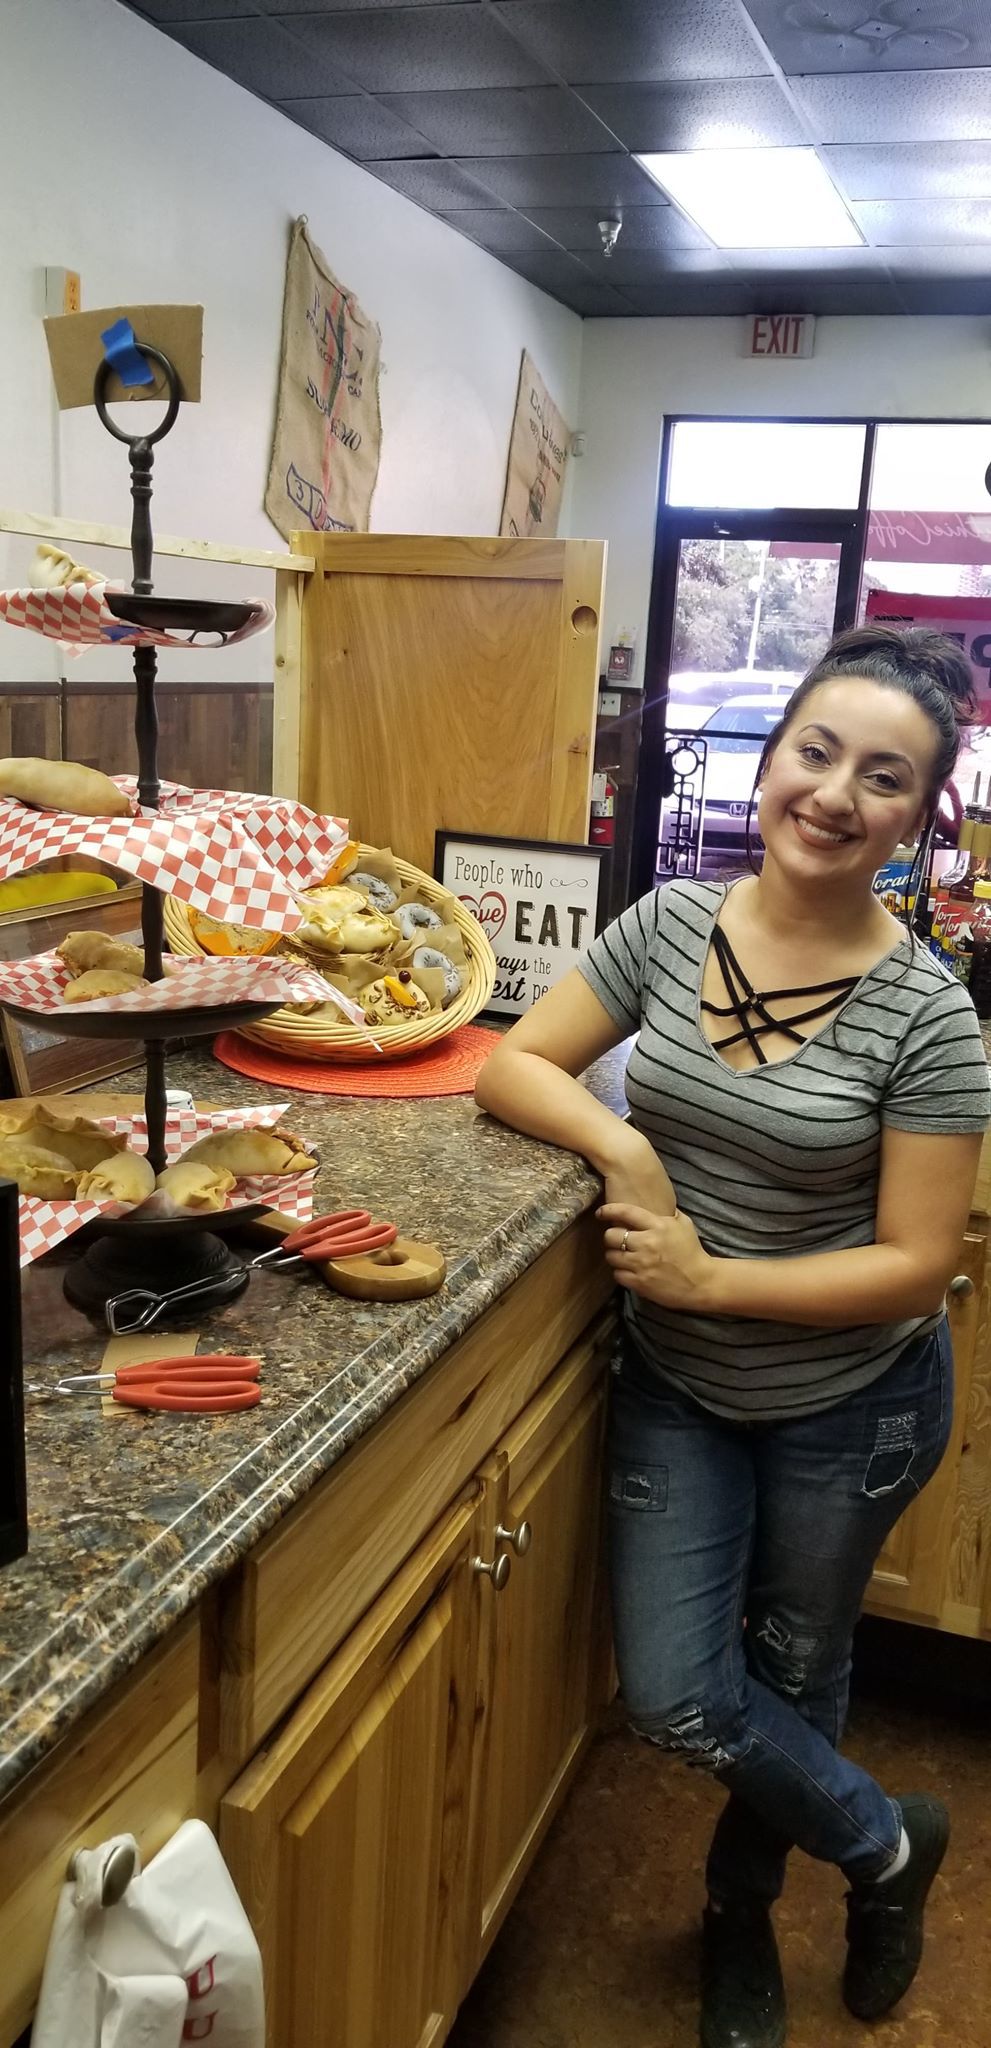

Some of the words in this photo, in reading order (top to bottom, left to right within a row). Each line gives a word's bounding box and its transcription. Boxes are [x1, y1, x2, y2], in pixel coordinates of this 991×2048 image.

[752, 317, 804, 353] EXIT
[455, 856, 504, 888] People
[511, 864, 543, 889] who
[871, 867, 916, 890] Torani
[467, 906, 505, 924] ove
[515, 900, 588, 949] EAT
[533, 958, 551, 975] the
[491, 977, 525, 1002] est
